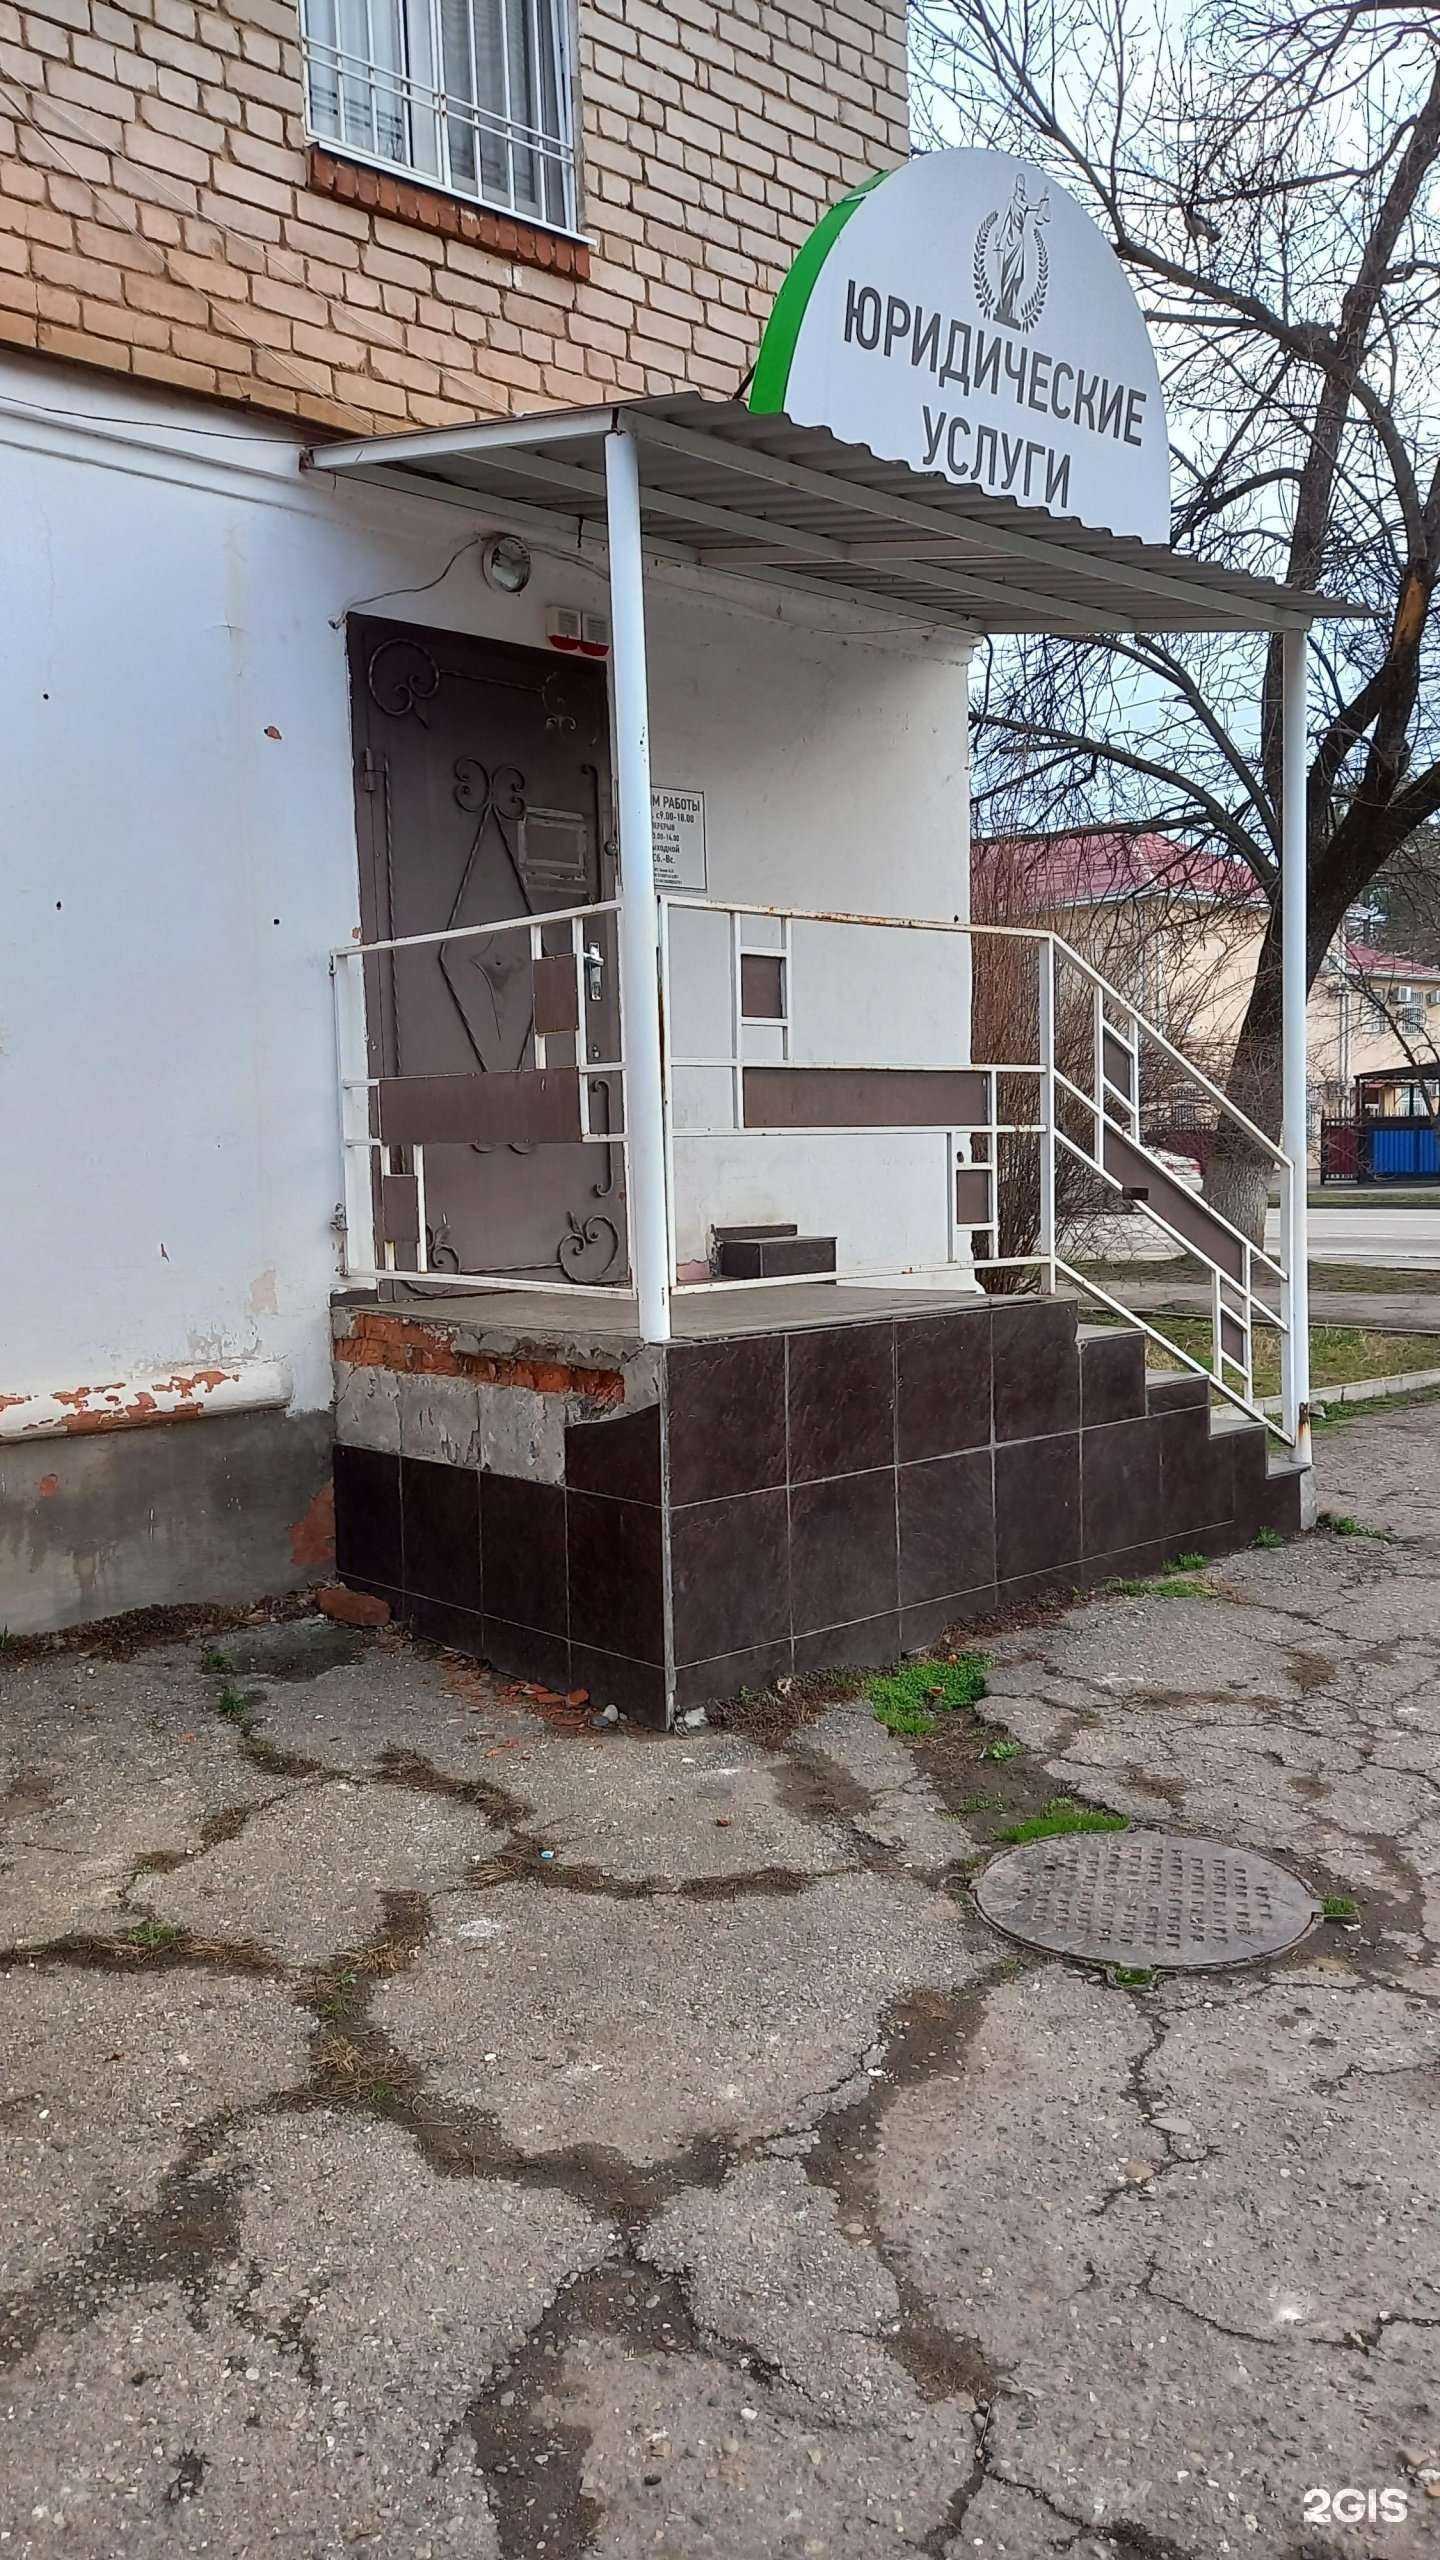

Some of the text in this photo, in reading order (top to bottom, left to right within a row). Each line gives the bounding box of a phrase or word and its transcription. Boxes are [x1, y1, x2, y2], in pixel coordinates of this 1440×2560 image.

[843, 279, 1148, 447] ЮРИДИЧЕСКИЕ
[922, 405, 1071, 509] УСЛУГИ
[663, 796, 700, 812] РАБОТЫ
